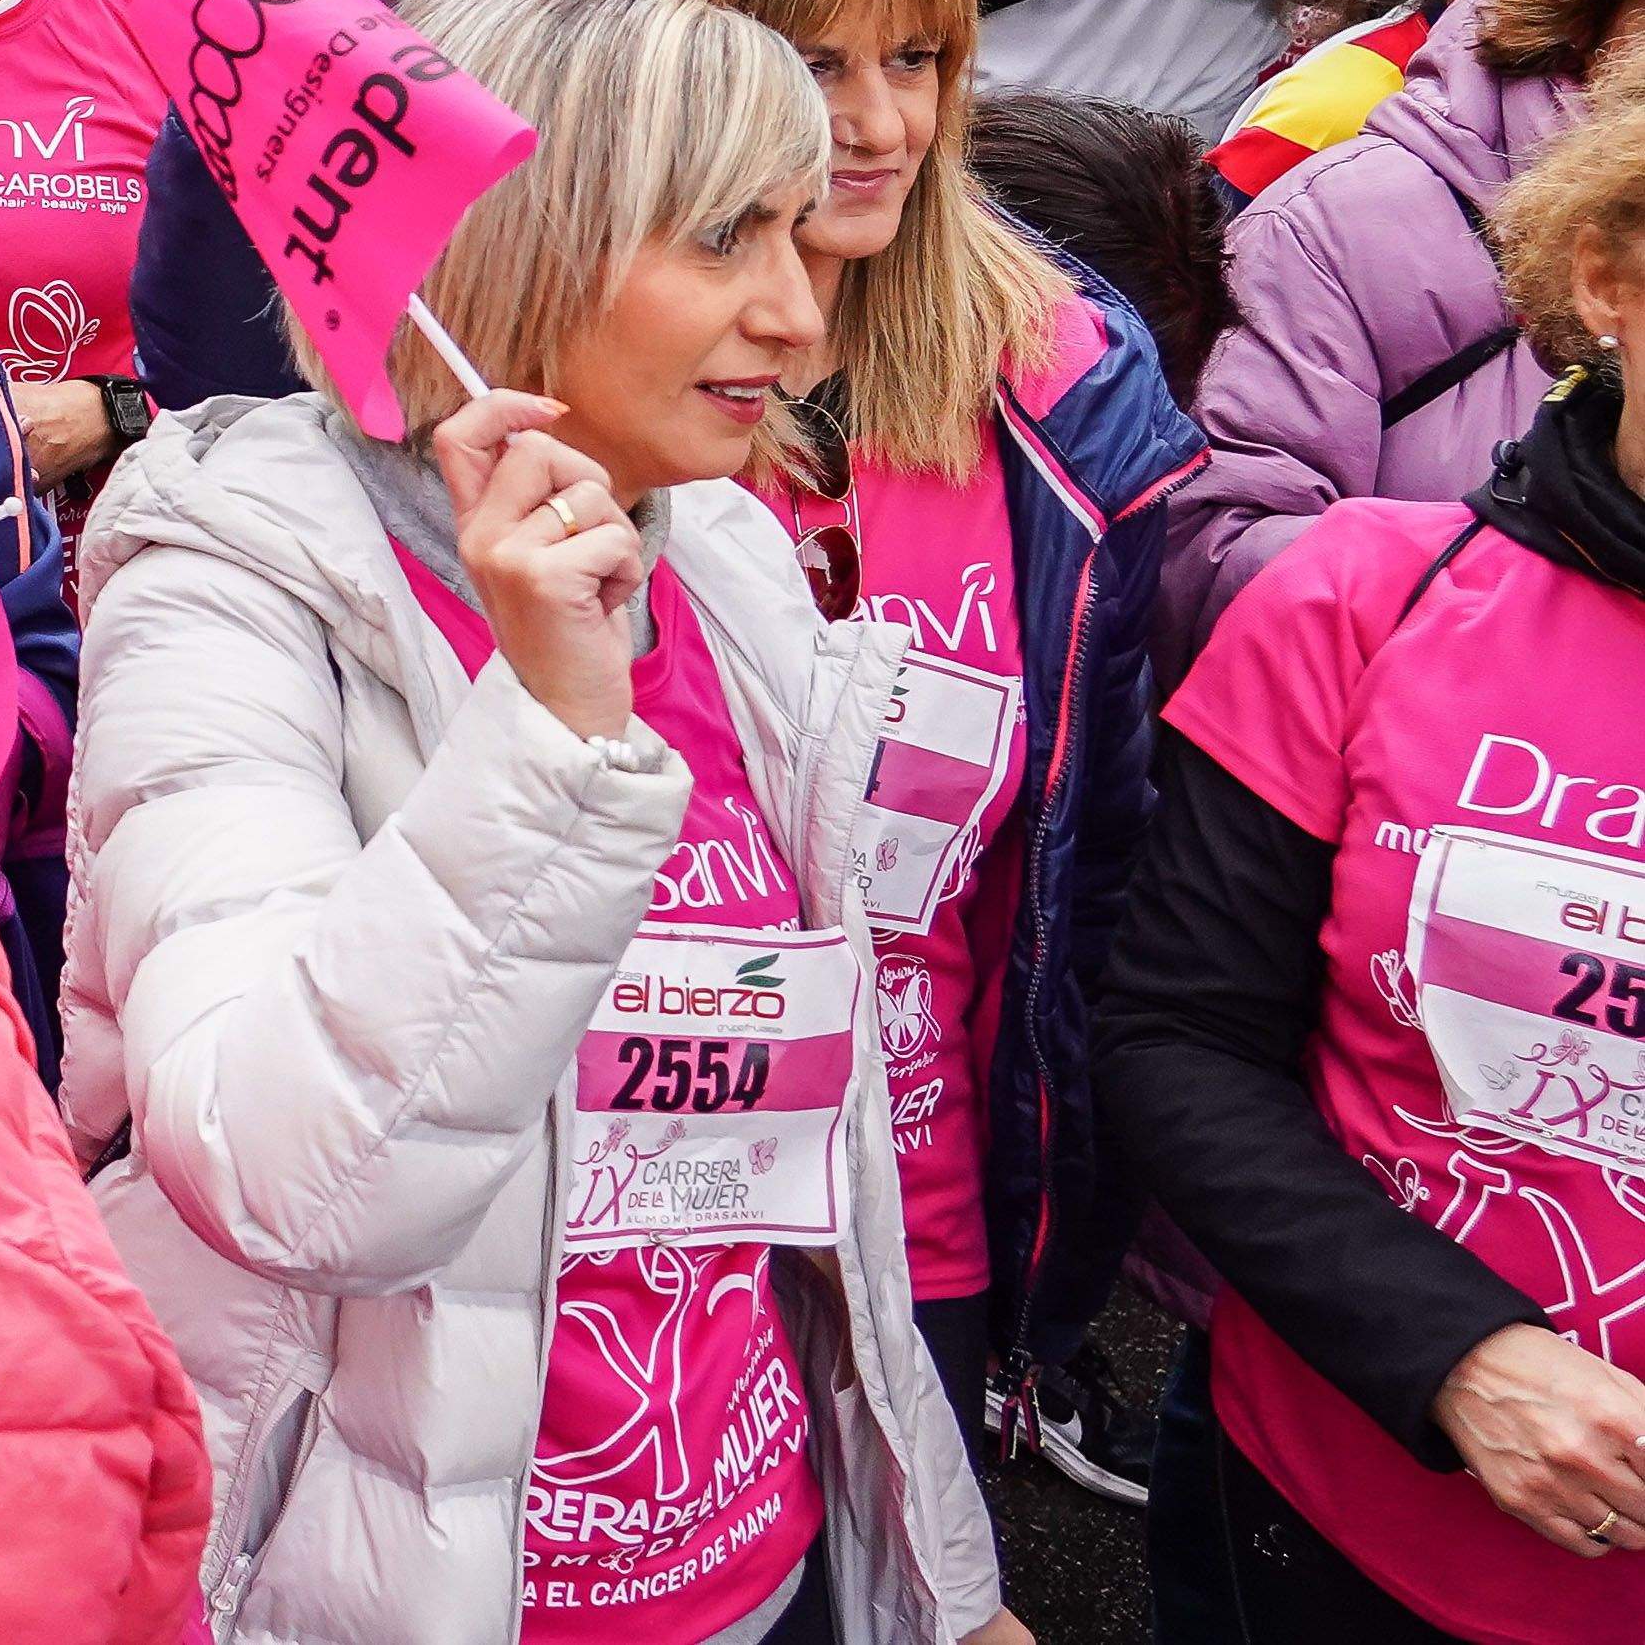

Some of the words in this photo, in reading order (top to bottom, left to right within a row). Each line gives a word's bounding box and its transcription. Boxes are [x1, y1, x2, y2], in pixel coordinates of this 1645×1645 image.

[257, 31, 359, 184] Designers
[41, 197, 88, 214] beauty
[100, 200, 128, 215] style
[1558, 899, 1608, 935] el
[613, 974, 650, 1014] el
[659, 975, 785, 1020] bierzo
[611, 1036, 770, 1113] 2554
[641, 1157, 741, 1187] CARRERA
[627, 1191, 649, 1210] DE
[670, 1183, 750, 1213] MUJER
[694, 1209, 765, 1223] DRASANVI
[713, 1356, 800, 1511] MUJER
[546, 1581, 582, 1607] EL
[590, 1557, 697, 1606] CÁNCER
[701, 1536, 726, 1573] DE
